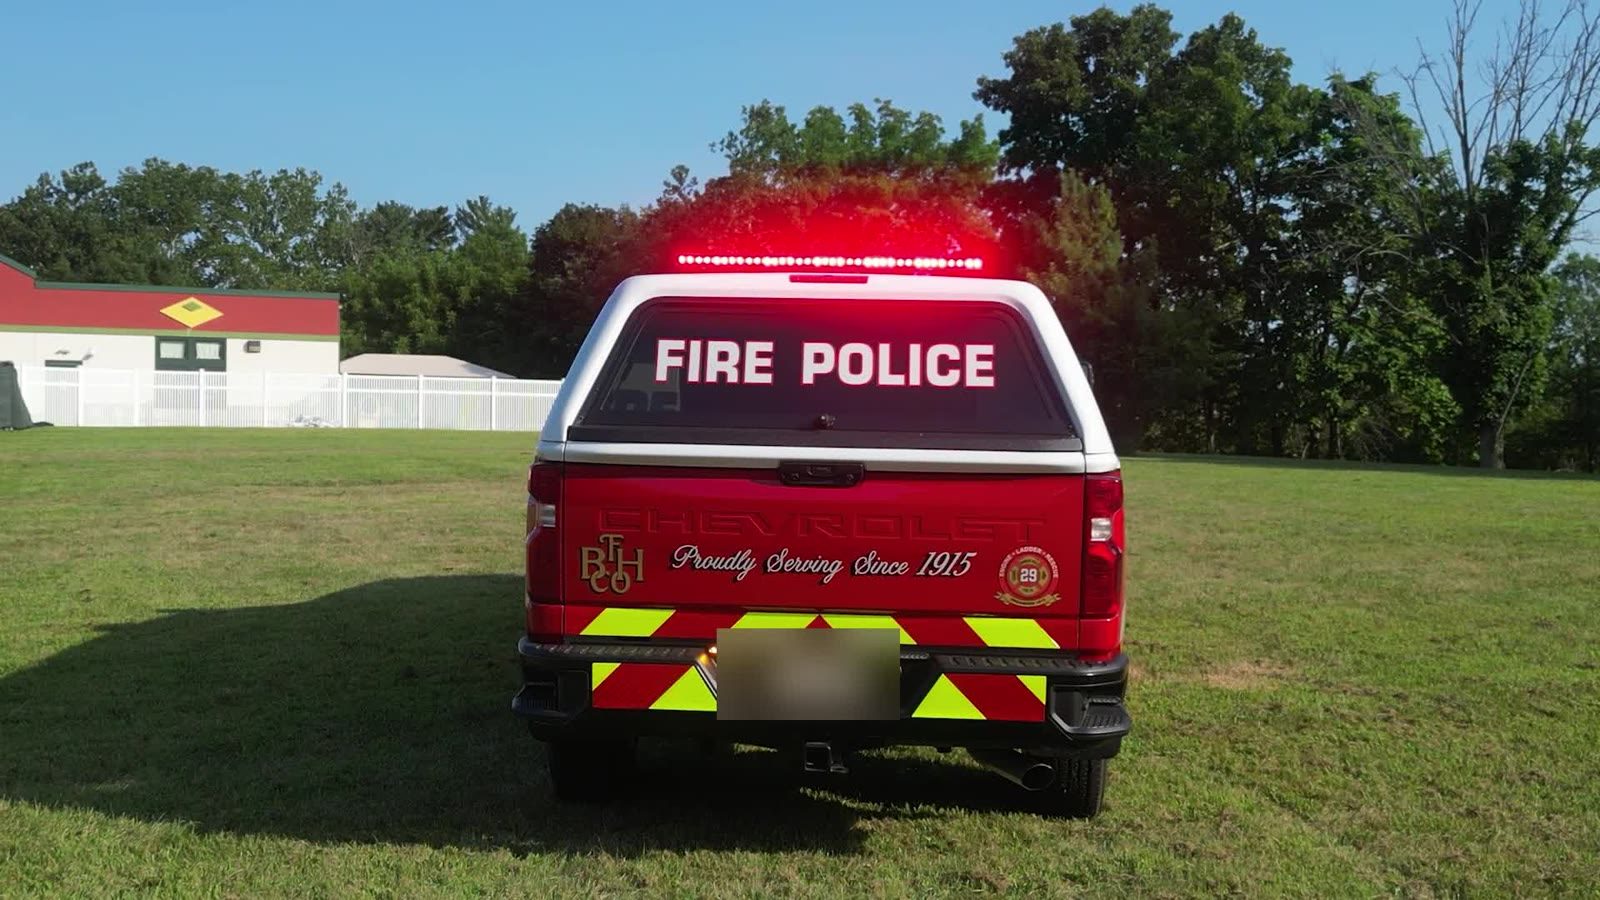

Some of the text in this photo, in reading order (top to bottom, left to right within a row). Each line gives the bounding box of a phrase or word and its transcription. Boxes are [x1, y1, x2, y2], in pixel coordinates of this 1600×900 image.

[655, 339, 995, 388] FIRE POLICE
[598, 506, 1046, 543] CHEVROLET
[671, 544, 978, 583] Proudly Serving Since 1915
[1020, 568, 1037, 582] 29
